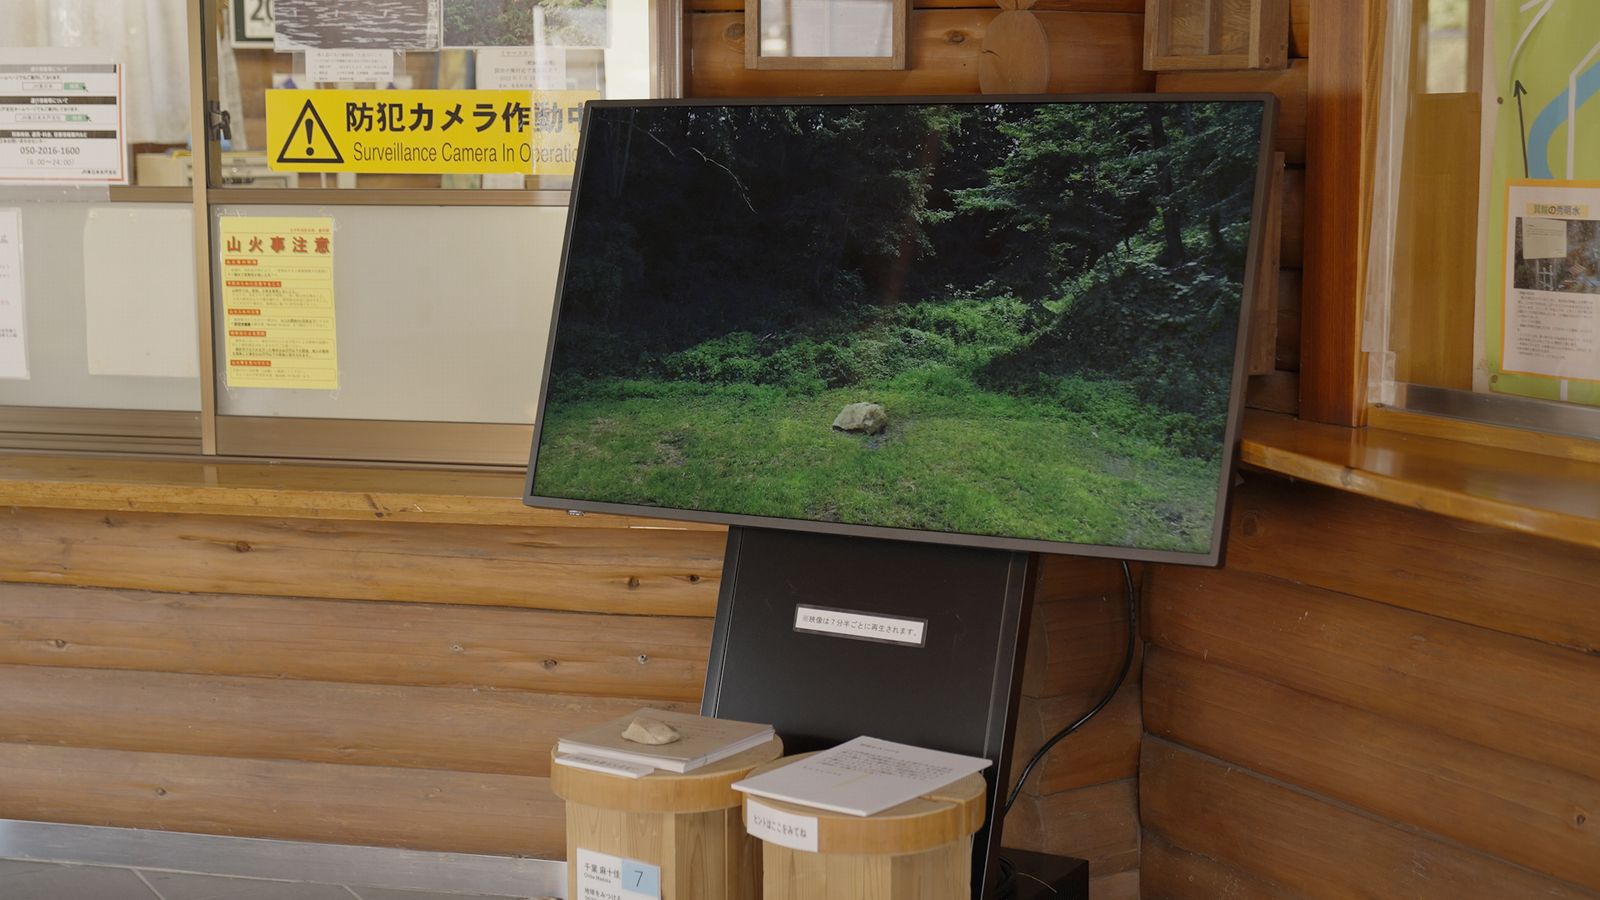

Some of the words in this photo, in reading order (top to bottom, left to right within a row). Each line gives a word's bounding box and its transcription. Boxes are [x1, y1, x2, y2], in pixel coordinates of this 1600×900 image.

[353, 141, 437, 162] Surveillance
[442, 143, 498, 163] Camera
[503, 144, 515, 163] In
[520, 143, 577, 167] Operatio
[227, 236, 330, 254] 山火事注意
[634, 870, 644, 888] 7
